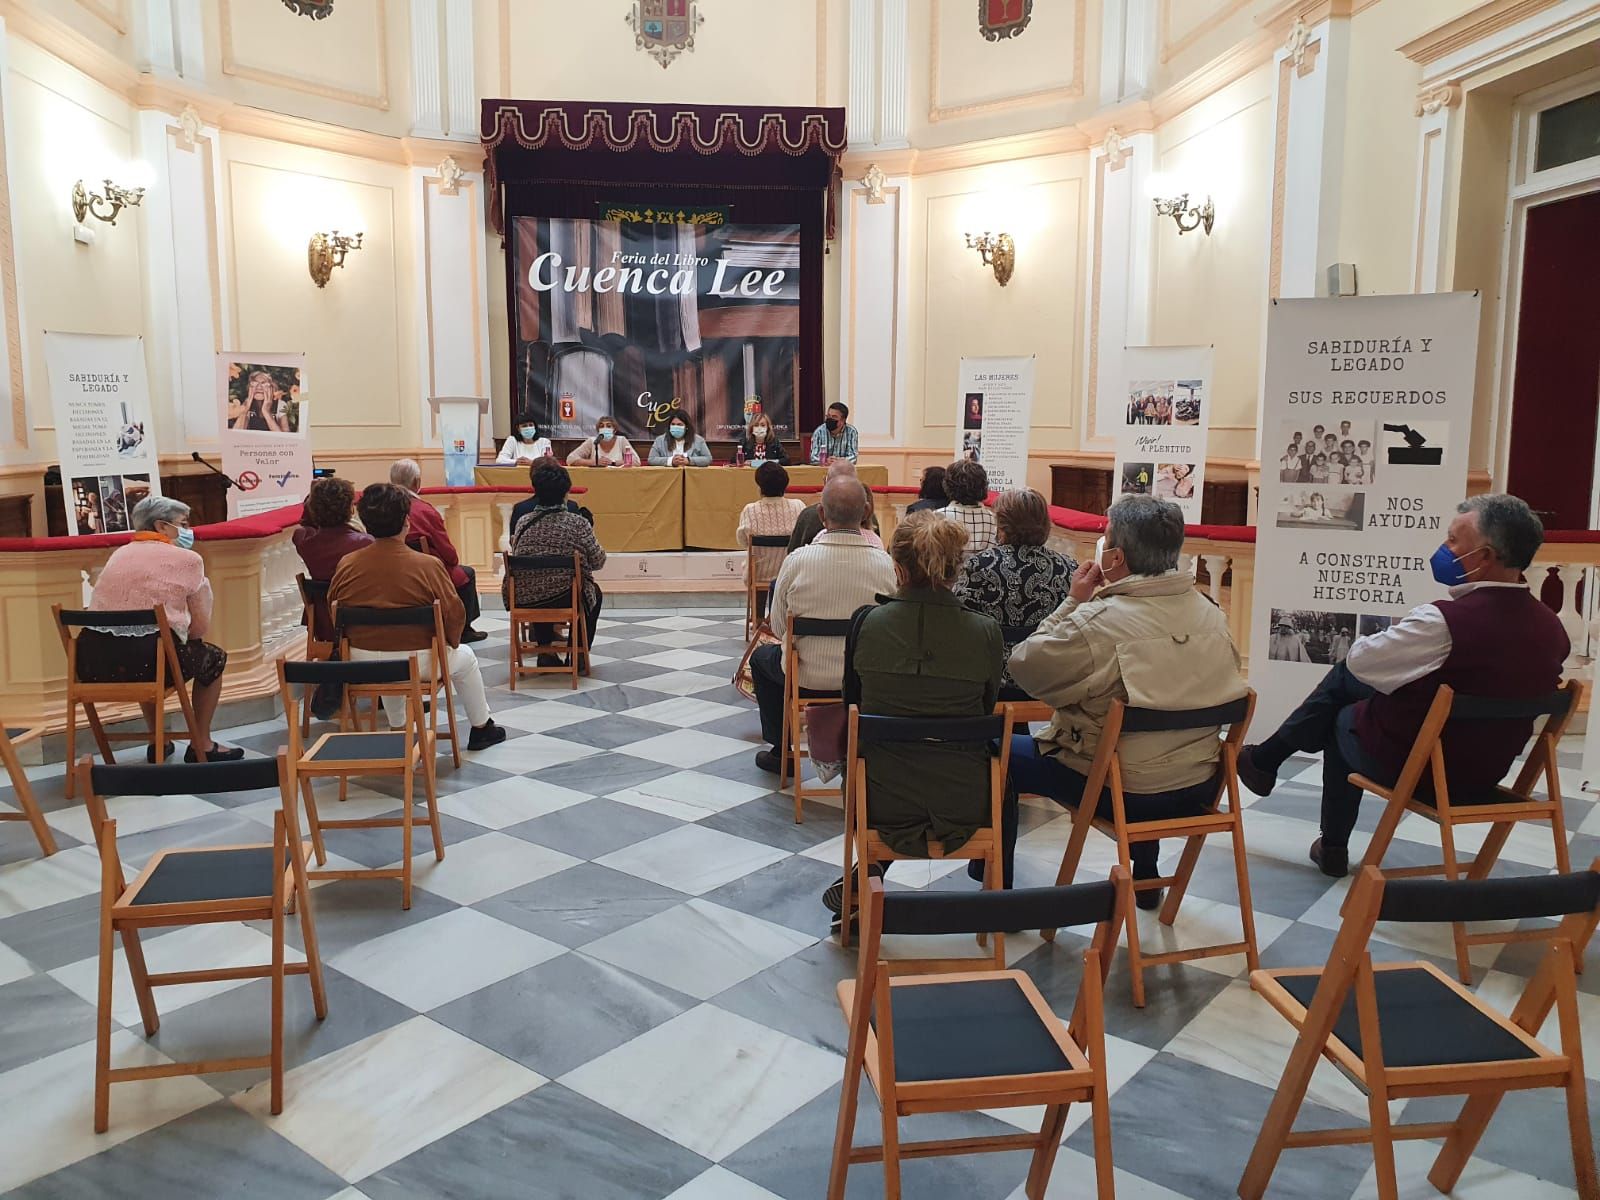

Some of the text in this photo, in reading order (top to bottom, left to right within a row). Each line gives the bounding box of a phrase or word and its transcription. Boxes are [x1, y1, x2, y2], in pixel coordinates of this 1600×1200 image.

[611, 251, 709, 267] Feria del Libro
[528, 252, 786, 296] Cuenca Lee
[1307, 336, 1432, 354] SABIDURÍA Y
[1331, 357, 1404, 372] LEGADO
[69, 373, 129, 383] SABIDURÍA Y
[82, 384, 119, 392] LEGADO
[1288, 391, 1447, 405] SUS RECUERDOS
[1149, 444, 1192, 453] PLENITUD
[1387, 497, 1424, 511] NOS
[1368, 514, 1441, 529] AYUDAN
[1299, 552, 1425, 571] A CONSTRUIR
[1318, 570, 1403, 587] NUESTRA
[1313, 587, 1406, 605] HISTORIA
